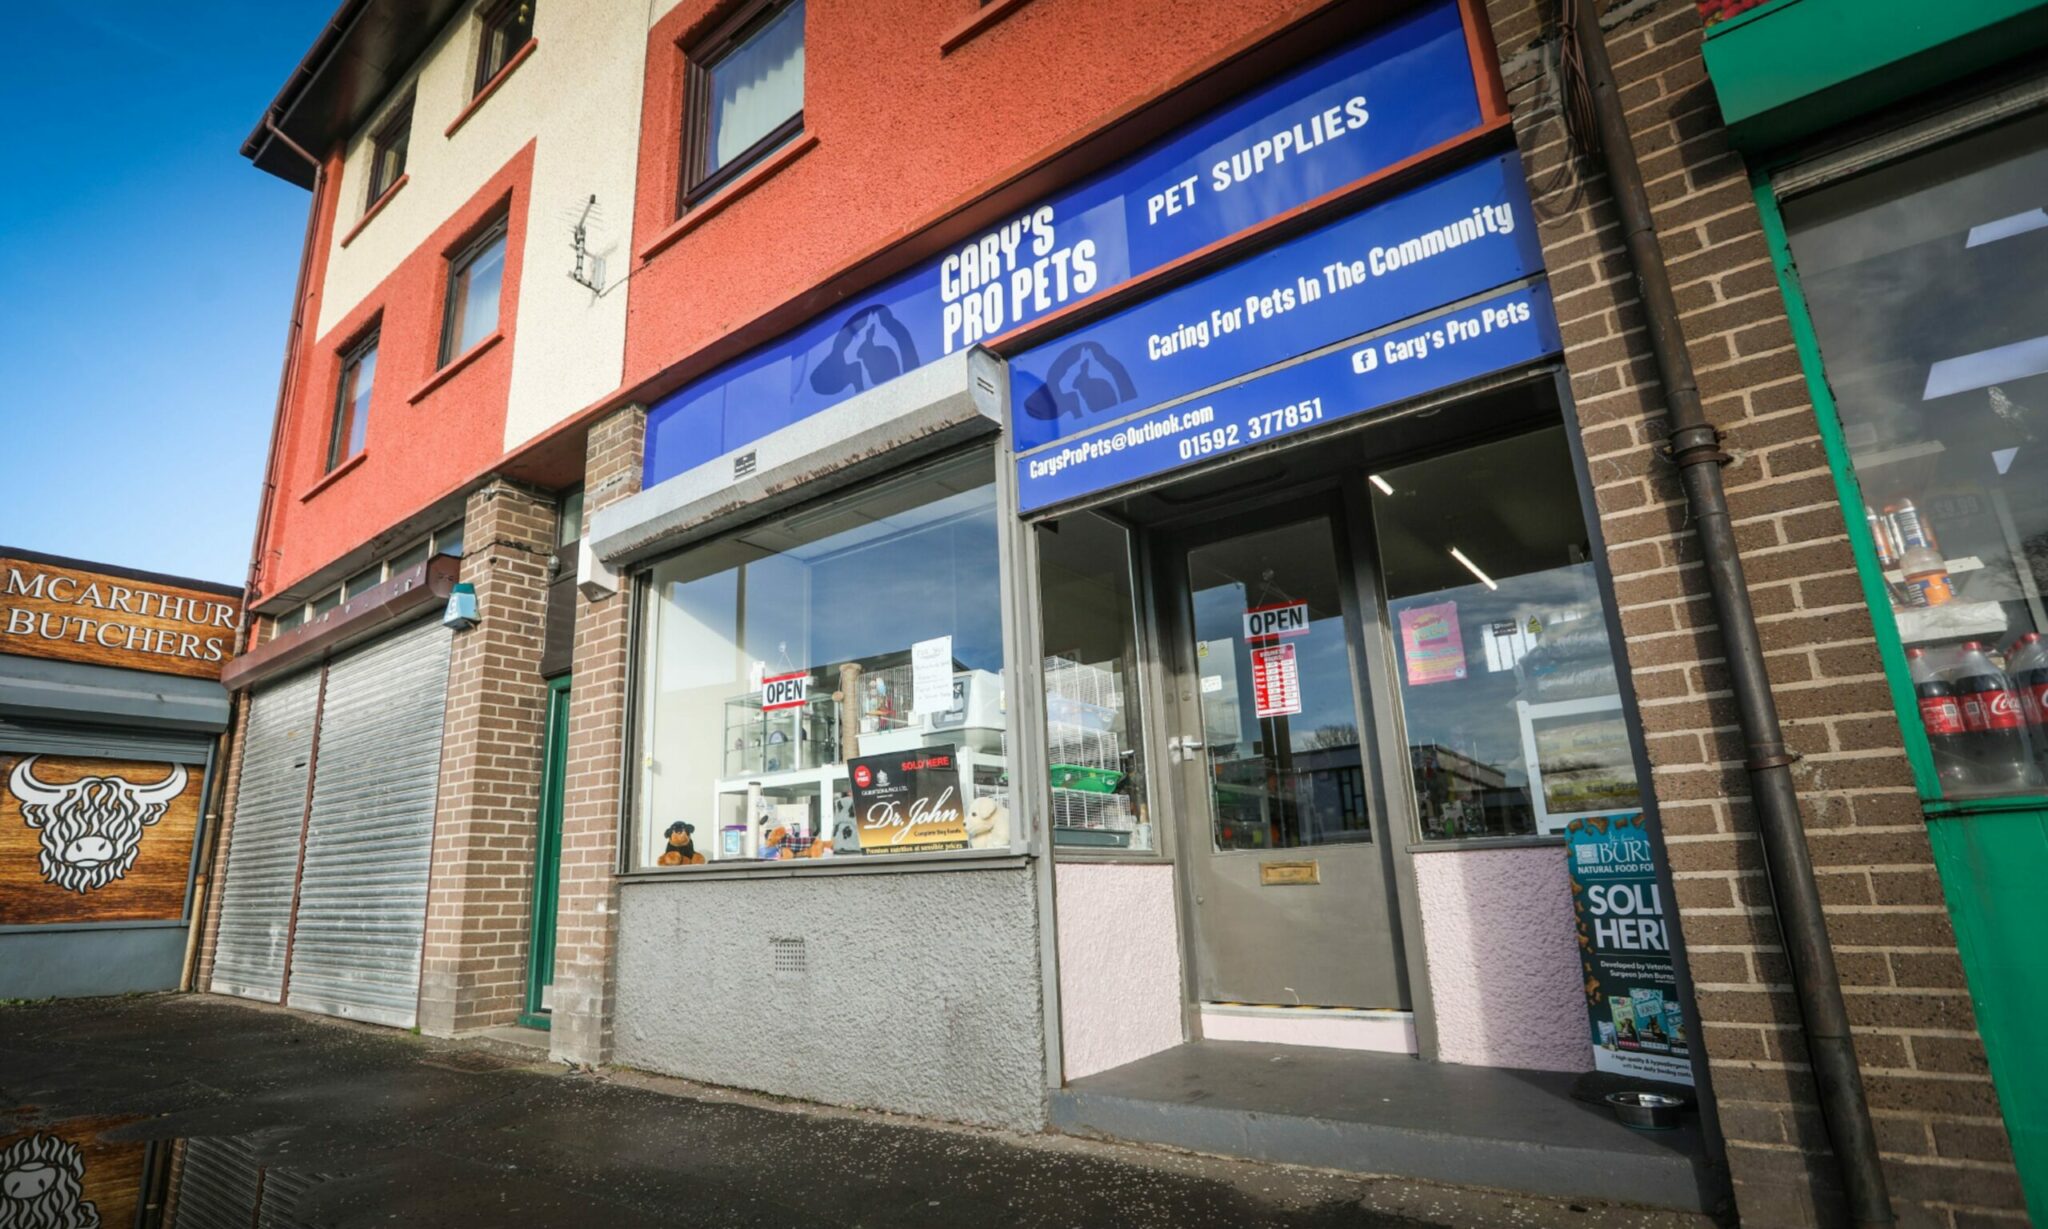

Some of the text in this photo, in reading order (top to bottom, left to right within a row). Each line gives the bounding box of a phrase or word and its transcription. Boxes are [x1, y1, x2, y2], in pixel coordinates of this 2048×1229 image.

[1147, 95, 1370, 226] PET SUPPLIES
[940, 204, 1055, 304] CARY'S
[1148, 202, 1516, 361] Caring For Pets In The Community
[942, 239, 1098, 355] PRO PETS
[1384, 329, 1445, 365] Cary's
[1446, 318, 1481, 345] Pro
[1481, 301, 1531, 334] Pets
[1029, 405, 1214, 480] CarysProPets@Outlook.com
[1178, 397, 1324, 461] 01592 377851
[4, 568, 237, 629] MCARTHUR
[1249, 606, 1303, 636] OPEN
[4, 607, 224, 662] BUTCHERS
[766, 678, 803, 705] OPEN
[901, 756, 950, 772] SOLD HERE
[892, 785, 959, 845] John
[1578, 865, 1614, 875] NATURAL
[1615, 864, 1639, 873] FOOD
[1600, 960, 1636, 970] Developed
[1636, 961, 1645, 971] by
[1609, 969, 1637, 979] Surgeon
[1638, 971, 1654, 979] John
